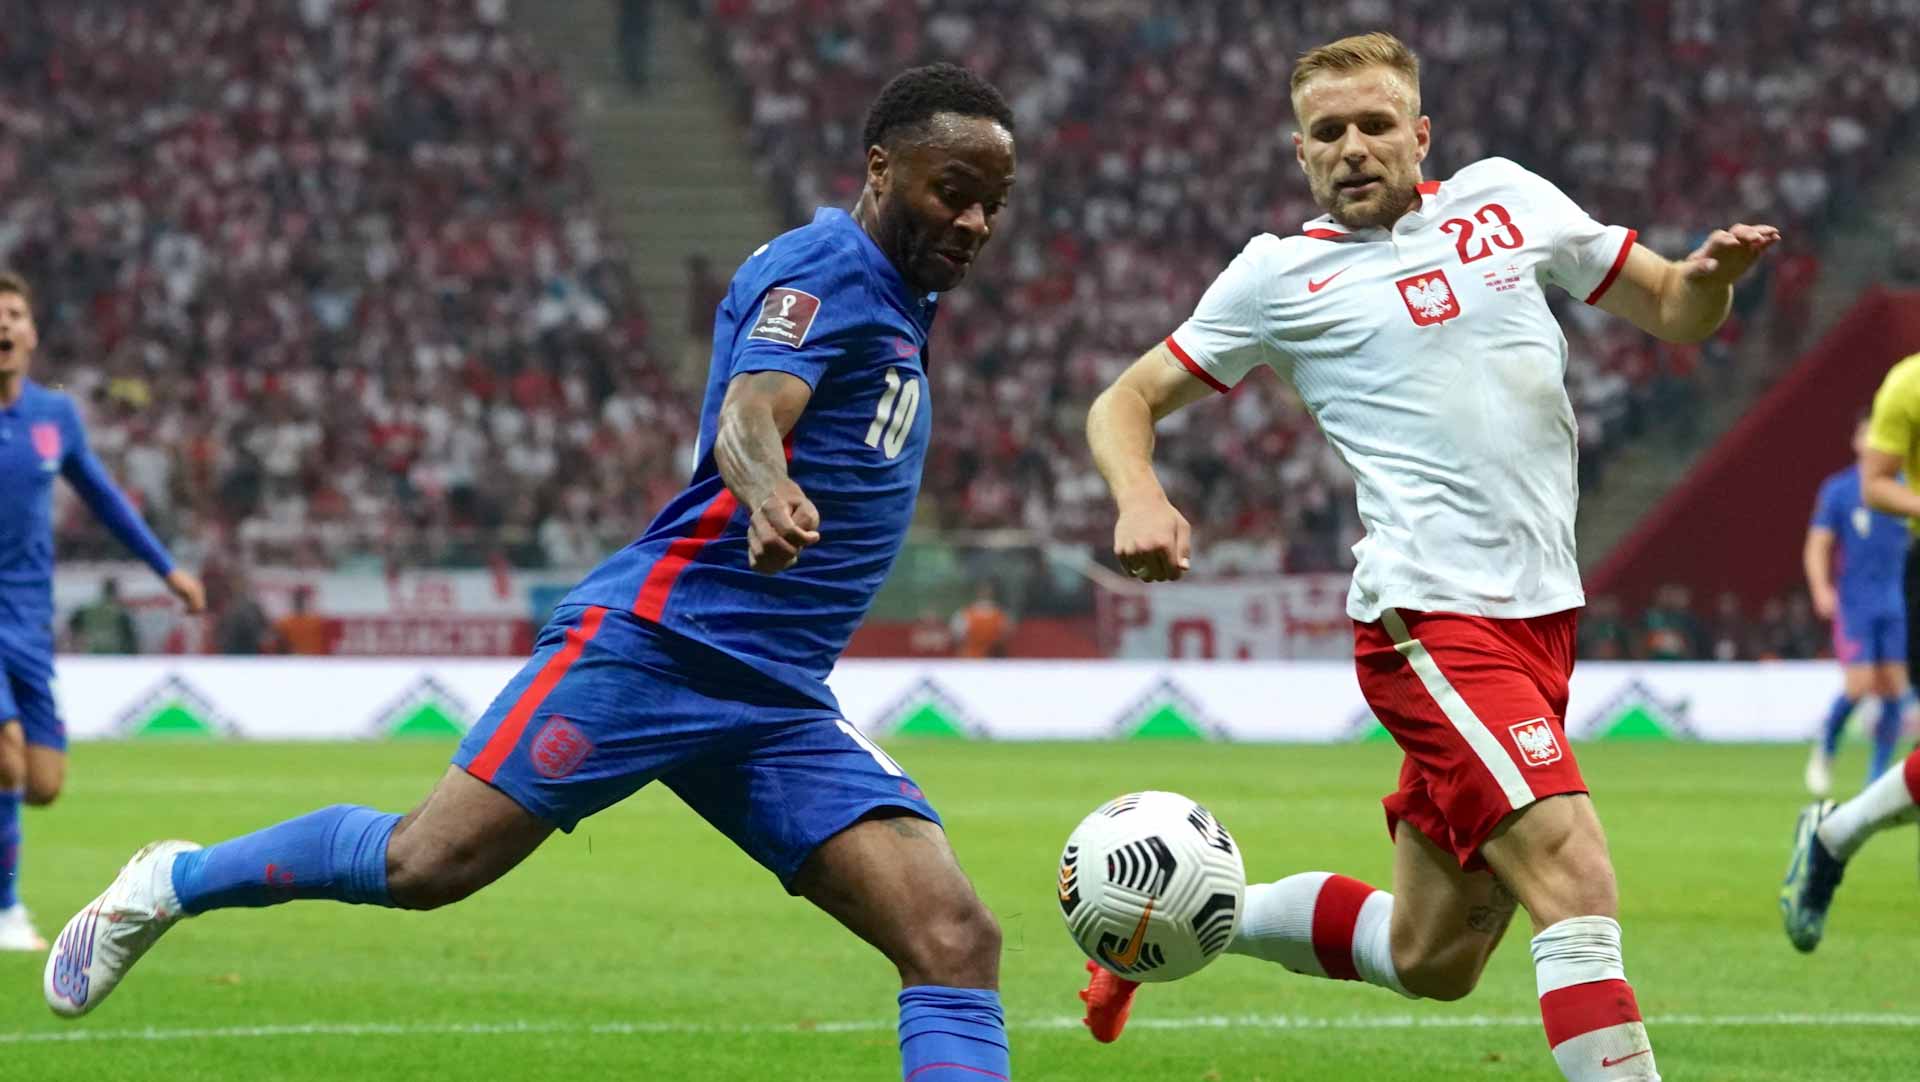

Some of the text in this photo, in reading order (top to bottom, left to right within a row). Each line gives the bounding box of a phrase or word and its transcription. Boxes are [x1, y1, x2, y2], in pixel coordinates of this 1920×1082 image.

[1439, 203, 1524, 264] 23
[864, 367, 920, 460] 10
[834, 719, 904, 777] 1
